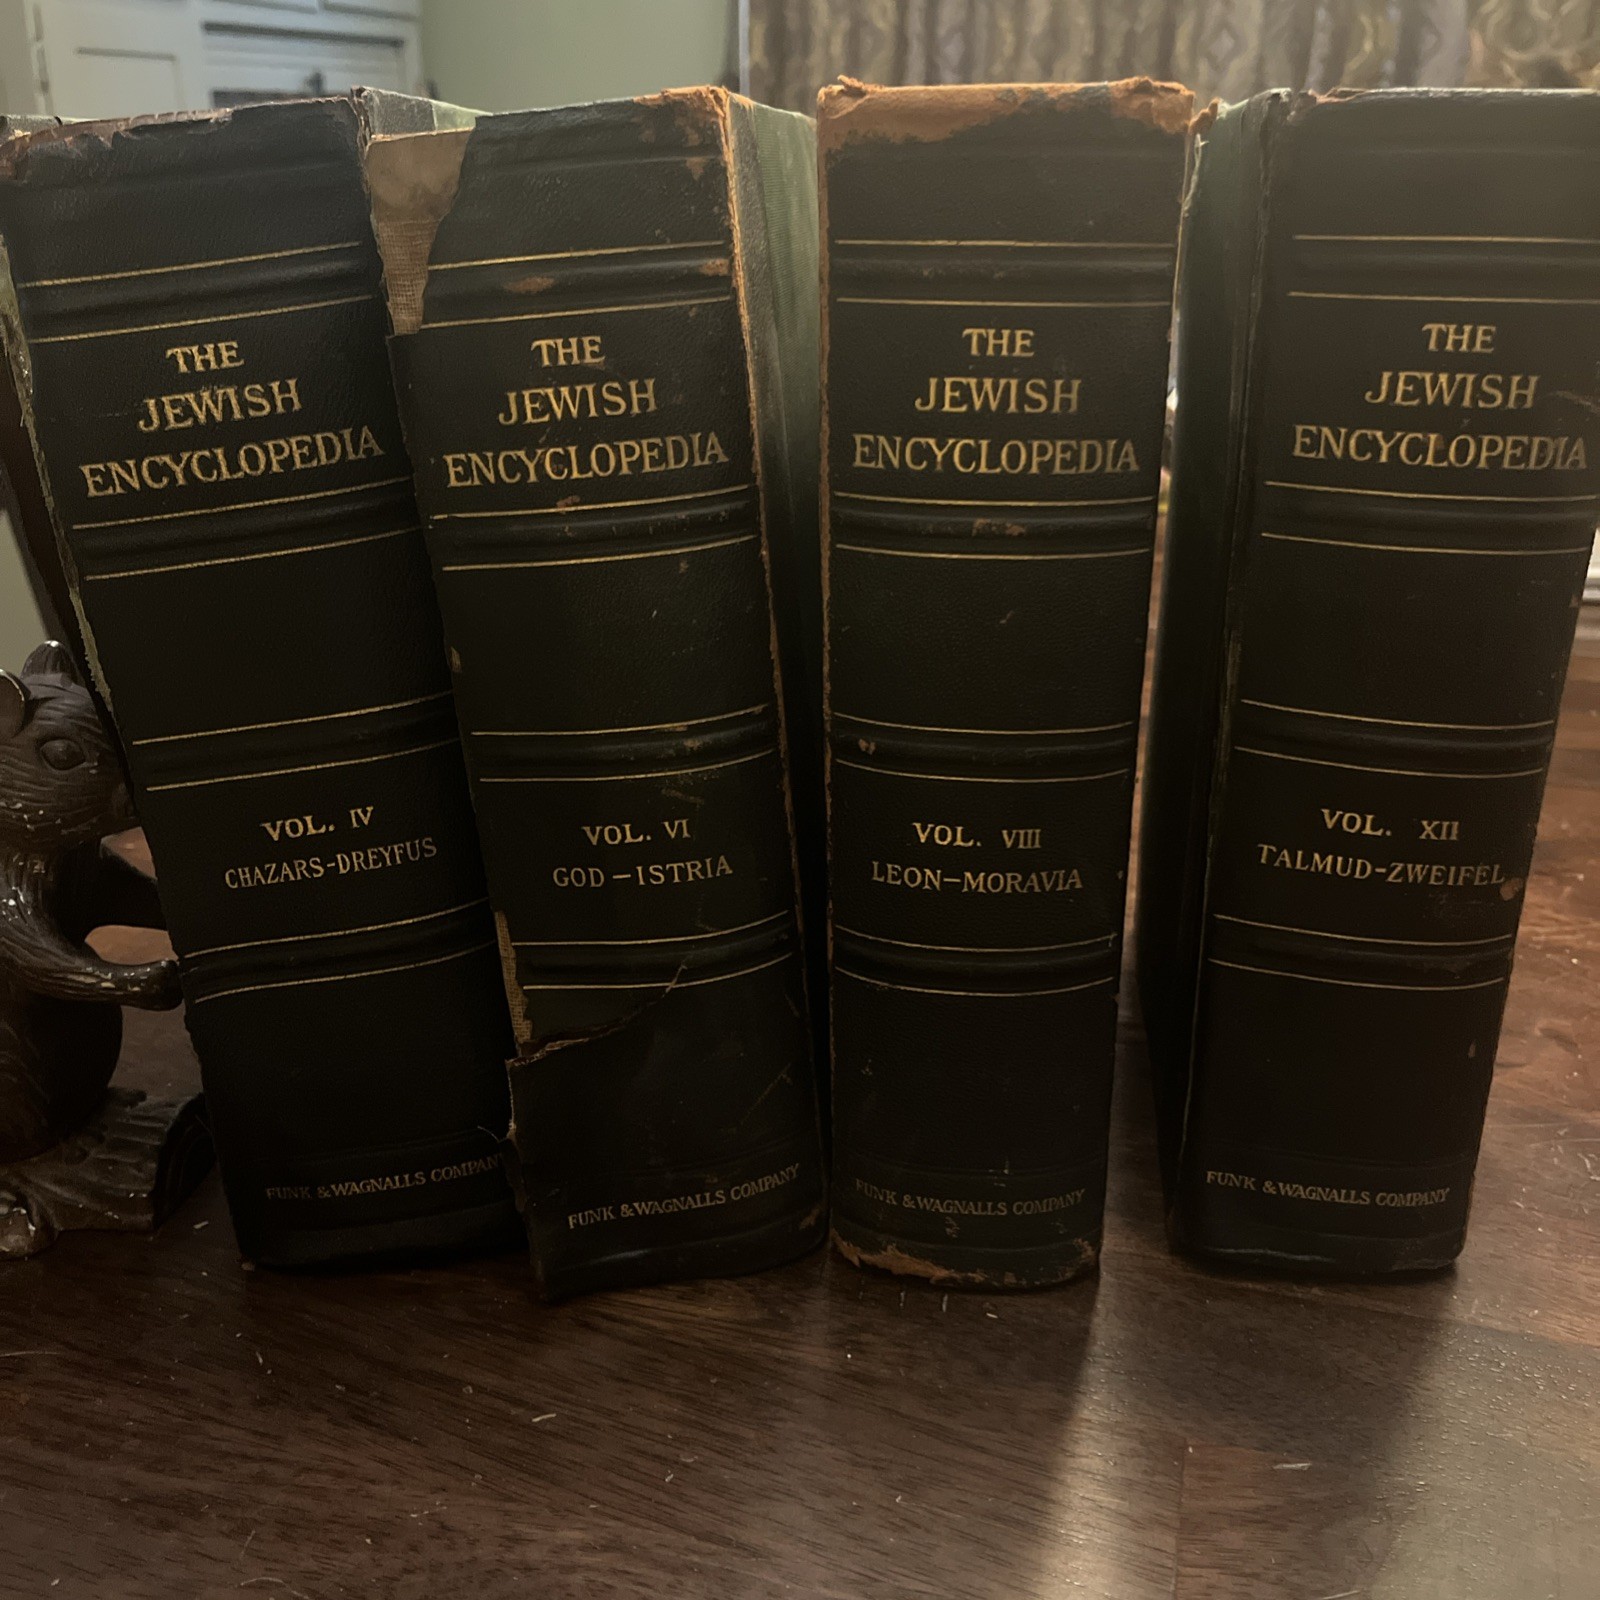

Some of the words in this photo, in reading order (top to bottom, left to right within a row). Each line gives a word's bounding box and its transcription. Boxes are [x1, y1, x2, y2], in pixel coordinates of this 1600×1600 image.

[165, 340, 245, 374] THE
[530, 335, 605, 368] THE
[959, 328, 1035, 357] THE
[1422, 322, 1496, 353] THE
[136, 377, 302, 433] JEWISH
[498, 377, 657, 425] JEWISH
[914, 376, 1082, 414] JEWISH
[1364, 370, 1541, 410] JEWISH
[78, 424, 385, 498] ENCYCLOPEDIA
[442, 431, 730, 488] ENCYCLOPEDIA
[851, 433, 1141, 475] ENCYCLOPEDIA
[1291, 424, 1588, 470] ENCYCLOPEDIA
[260, 815, 336, 842] VOL.
[349, 805, 374, 829] IV
[582, 823, 652, 846] VOL.
[662, 818, 692, 839] VI
[912, 821, 982, 847] VOL.
[1001, 828, 1042, 850] VIII
[1321, 808, 1392, 837] VOL.
[1418, 819, 1460, 841] XII
[224, 836, 438, 889] CHAZARS-DREYFUS
[1257, 843, 1505, 886] TALMUD-ZWEIFEL
[265, 1185, 312, 1200] FUNK
[430, 1153, 503, 1182] COMPAN
[1206, 1170, 1257, 1191] FUNK
[1375, 1187, 1451, 1207] COMPANY
[567, 1206, 615, 1230] FUNK
[730, 1163, 800, 1201] COMPANY
[855, 1178, 897, 1206] FUNK
[1012, 1187, 1086, 1216] COMPANY
